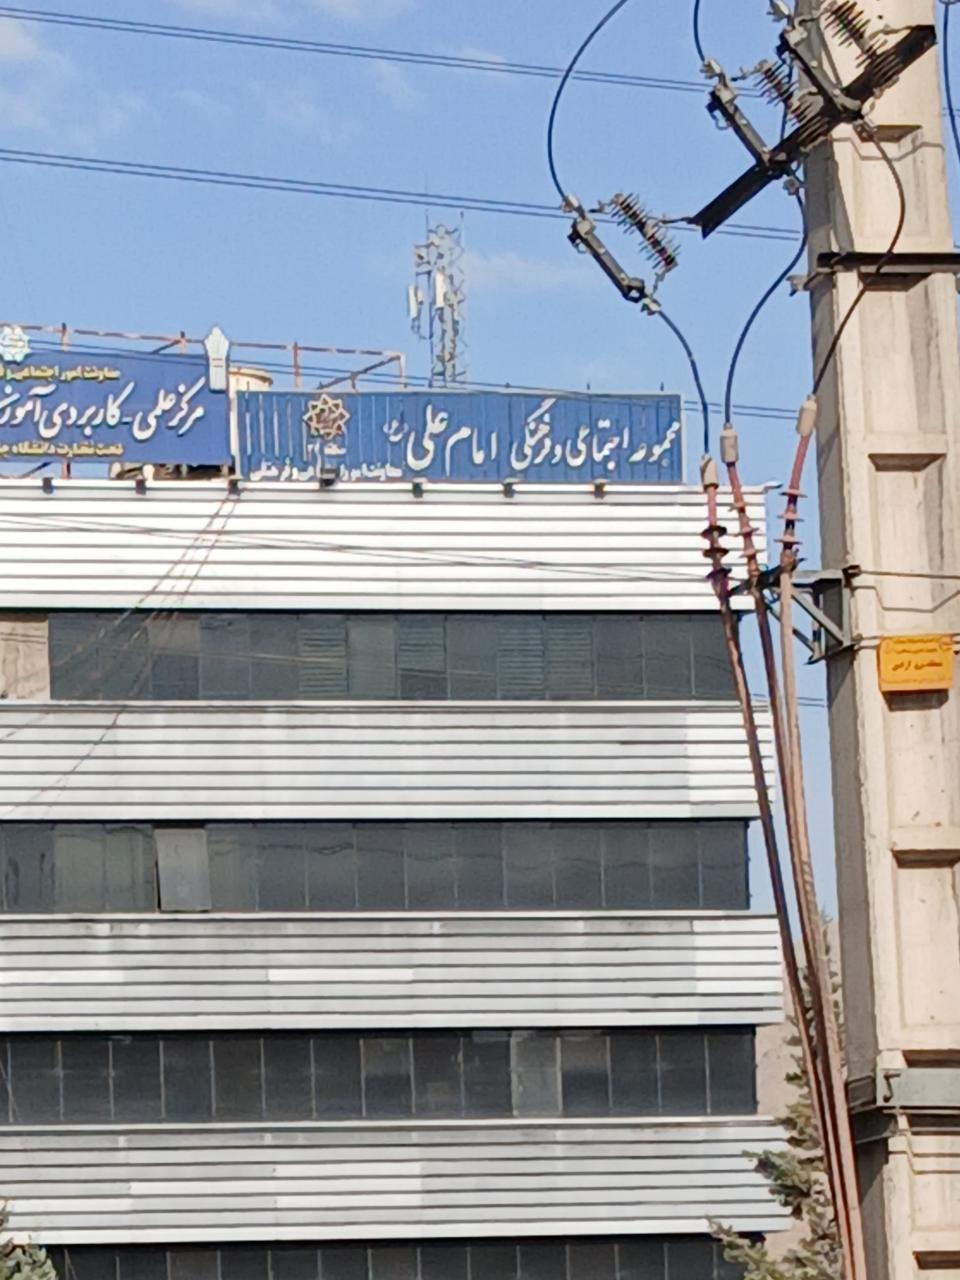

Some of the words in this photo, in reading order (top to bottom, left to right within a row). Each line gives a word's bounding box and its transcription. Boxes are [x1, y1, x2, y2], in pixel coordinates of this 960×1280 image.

[38, 381, 135, 438] کاربردی
[132, 388, 177, 441] علمی
[168, 375, 207, 436] مرکز
[406, 404, 449, 471] علی
[445, 426, 498, 477] امام
[510, 398, 557, 471] فرهنگی
[551, 443, 562, 465] و
[565, 417, 630, 471] اجتماعی
[628, 421, 681, 466] مجموعه
